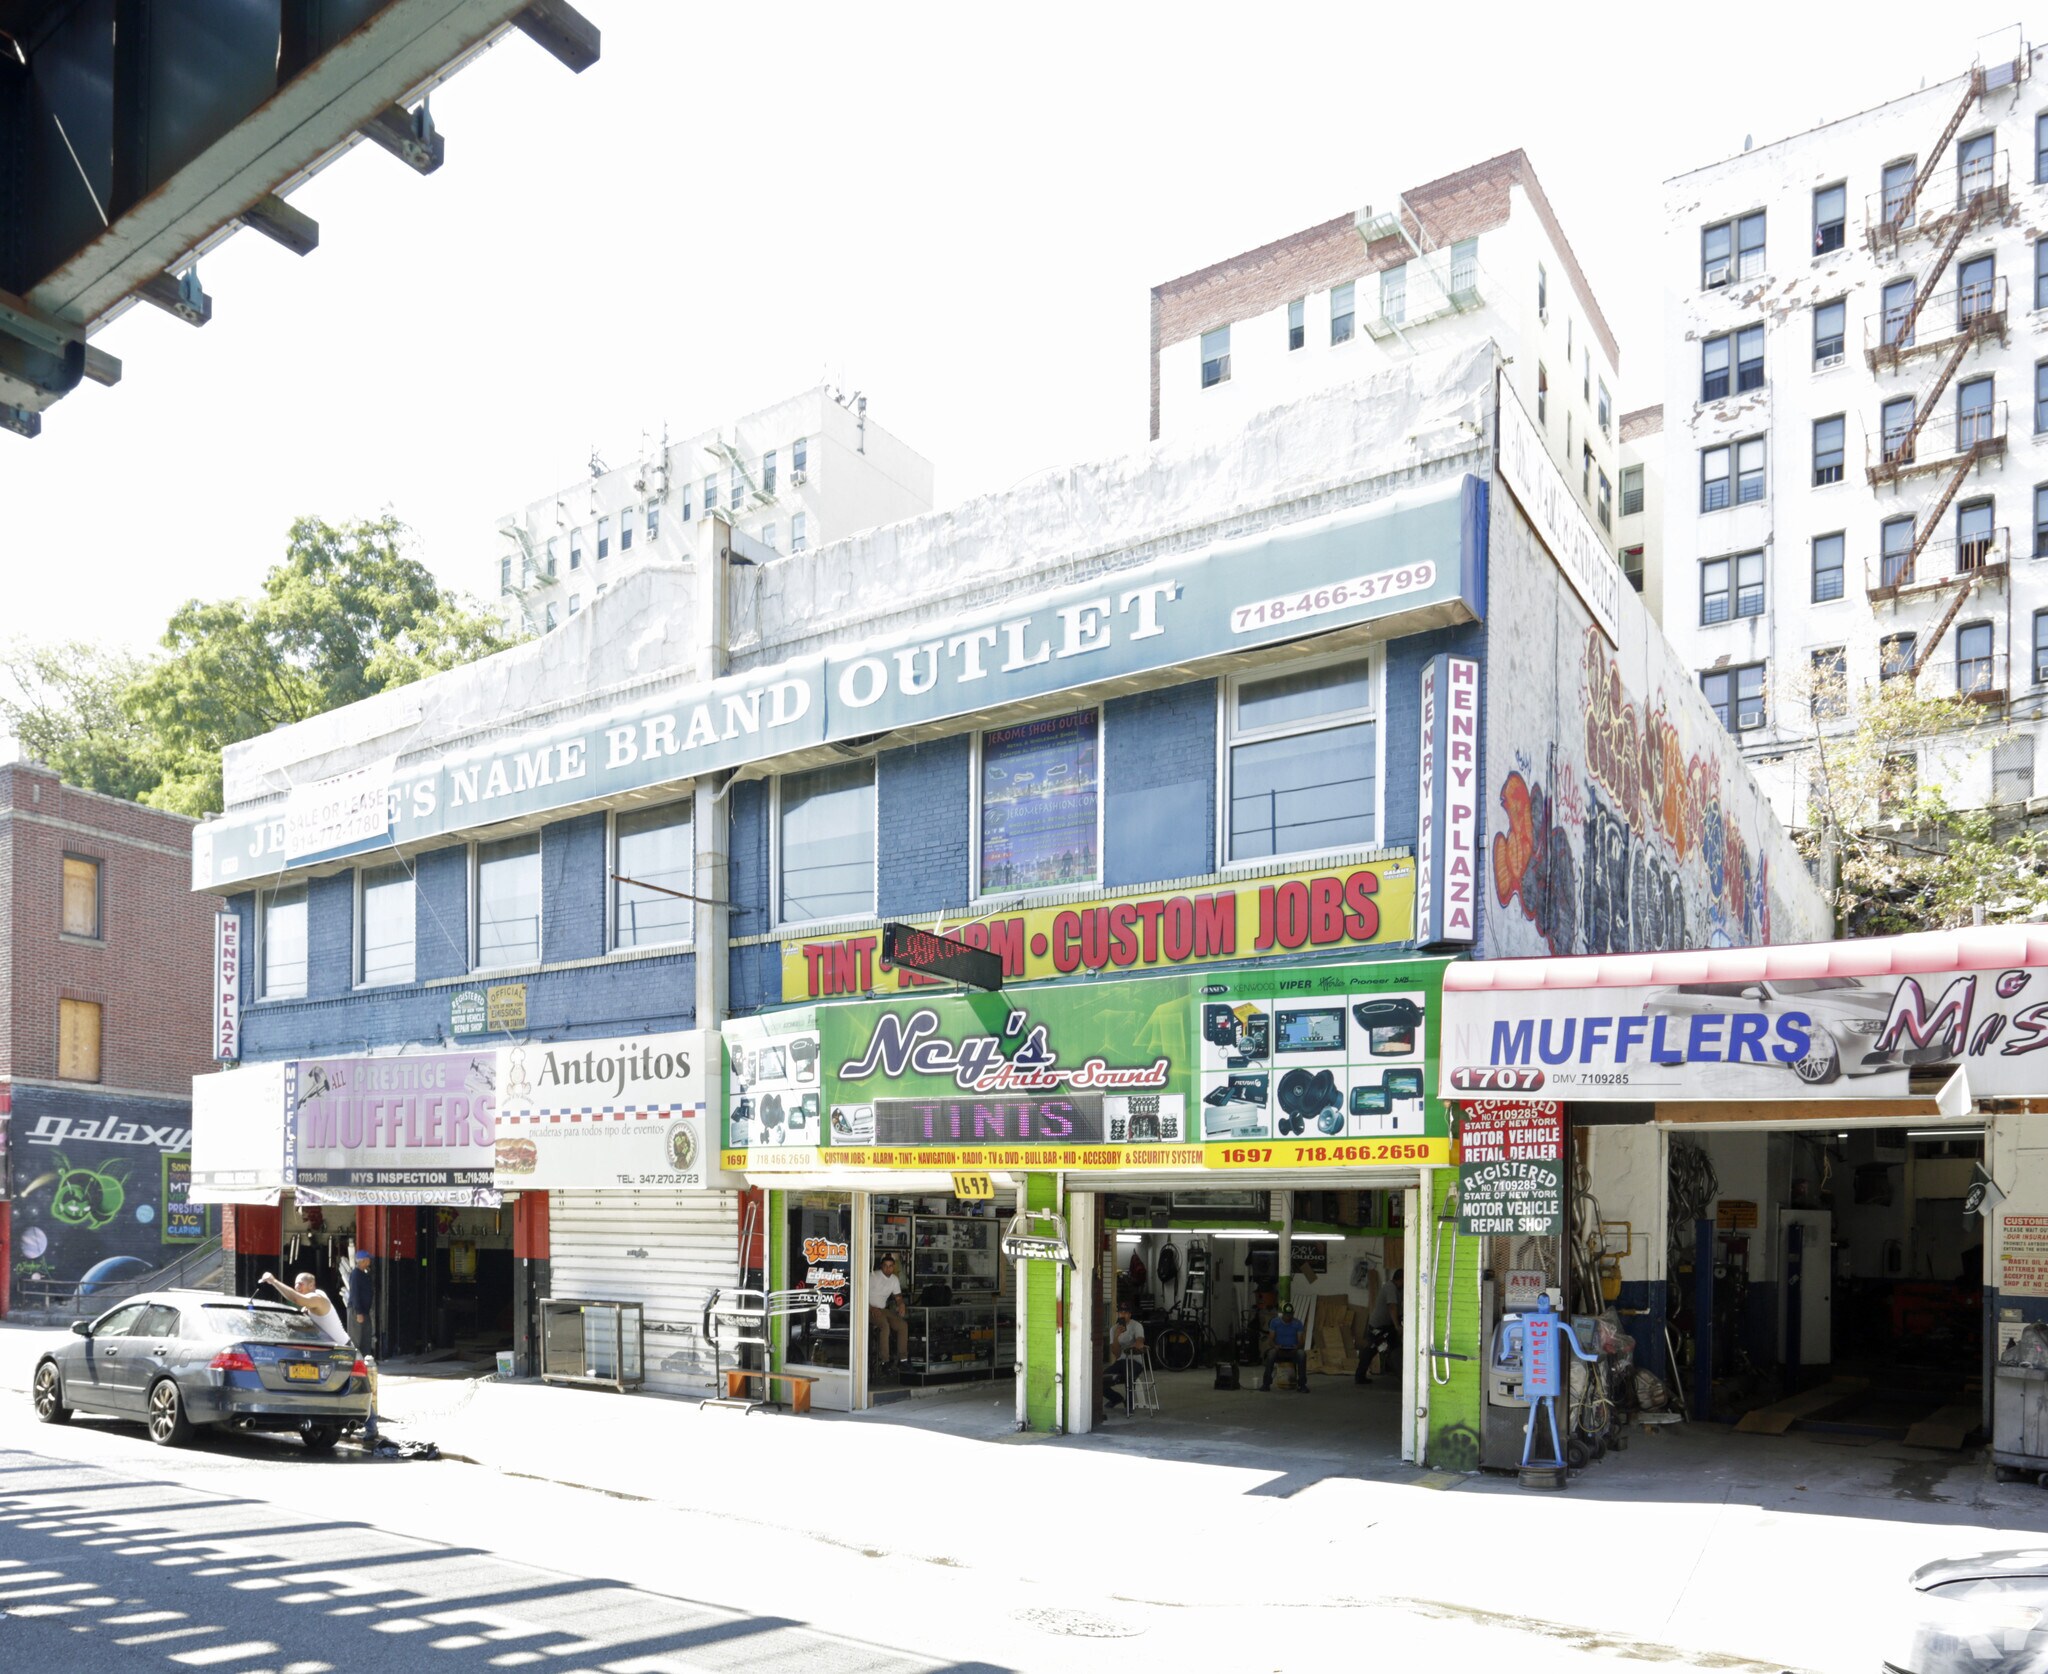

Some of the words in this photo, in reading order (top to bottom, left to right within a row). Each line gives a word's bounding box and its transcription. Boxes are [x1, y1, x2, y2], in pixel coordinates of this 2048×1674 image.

[1236, 565, 1432, 627] 718-466-3799
[249, 778, 436, 858] JEE'S
[450, 737, 588, 808] NAME
[605, 678, 811, 771] BRAND
[839, 581, 1178, 708] OUTLET
[988, 727, 1026, 746] JEROME
[1029, 719, 1056, 736] SHOES
[1059, 712, 1095, 729] OUTLET
[1452, 662, 1474, 788] HENRY
[1423, 674, 1433, 799] HENRY
[290, 807, 318, 832] SALE
[322, 801, 340, 822] OR
[344, 789, 385, 816] LEASE
[291, 813, 381, 852] 914-772-1780
[1450, 804, 1472, 928] PLAZA
[1420, 815, 1431, 939] PLAZA
[803, 936, 876, 996] TINT
[1053, 890, 1236, 972] CUSTOM
[1254, 871, 1380, 950] JOBS
[223, 920, 237, 985] HENRY
[1233, 983, 1274, 992] KENWOOD
[1279, 979, 1312, 990] VIPER
[1349, 977, 1389, 985] Pioneer
[451, 991, 485, 1009] REGISTERED
[490, 988, 523, 1002] OFFICIAL
[221, 993, 235, 1058] PLAZA
[1490, 1011, 1812, 1066] MUFFLERS
[331, 1069, 346, 1090] ALL
[353, 1062, 446, 1092] PRESTIGE
[537, 1043, 691, 1099] Antojitos
[975, 1064, 1064, 1091] Auto
[1070, 1058, 1167, 1088] Sound
[1455, 1070, 1539, 1088] 1707
[1552, 1074, 1576, 1084] DMV
[1581, 1074, 1629, 1084] 7109285
[286, 1067, 296, 1182] MUFFLERS
[306, 1095, 496, 1149] MUFFLERS
[911, 1101, 1073, 1138] TINTS
[1465, 1120, 1491, 1130] STATE
[1494, 1120, 1506, 1129] OF
[1508, 1119, 1529, 1127] NEW
[1532, 1117, 1557, 1126] YORK
[1492, 1109, 1538, 1120] 7109285
[529, 1126, 562, 1138] picaderas
[564, 1126, 579, 1138] para
[581, 1124, 602, 1136] todos
[604, 1125, 619, 1138] tipo
[622, 1123, 631, 1135] de
[633, 1124, 664, 1135] eventos
[1463, 1130, 1504, 1146] MOTOR
[1508, 1127, 1560, 1144] VEHICLE
[727, 1155, 747, 1166] 1697
[824, 1152, 849, 1165] CUSTOM
[850, 1152, 865, 1165] JOBS
[873, 1152, 894, 1165] ALARM
[898, 1152, 912, 1164] TINT
[918, 1151, 956, 1165] NAVIGATION
[962, 1151, 983, 1164] RADIO
[988, 1151, 998, 1164] TV
[1005, 1151, 1020, 1164] DVD
[1025, 1151, 1041, 1164] BULL
[1043, 1151, 1057, 1164] BAR
[1063, 1151, 1076, 1164] HID
[1083, 1151, 1121, 1164] ACCESORY
[1125, 1152, 1131, 1164] &
[1133, 1151, 1171, 1164] SECURITY
[1171, 1150, 1203, 1164] SYSTEM
[1221, 1148, 1272, 1163] 1697
[1295, 1144, 1429, 1162] 718.466.2650
[1465, 1147, 1506, 1162] RETAIL
[1510, 1144, 1557, 1161] DEALER
[299, 1173, 328, 1183] 1703-1705
[352, 1173, 373, 1183] NYS
[377, 1172, 446, 1183] INSPECTION
[617, 1174, 636, 1184] TEL:
[639, 1174, 699, 1184] 347.270.2723
[954, 1175, 989, 1196] 1697
[1464, 1162, 1557, 1191] REGISTERED
[1493, 1180, 1537, 1191] 7109285
[170, 1182, 190, 1193] MT
[355, 1188, 472, 1204] CONDITIONED
[1464, 1191, 1491, 1200] STATE
[1494, 1191, 1506, 1200] OF
[1508, 1190, 1529, 1199] NEW
[1532, 1189, 1557, 1198] YORK
[1463, 1202, 1503, 1216] MOTOR
[1507, 1200, 1559, 1216] VEHICLE
[171, 1214, 198, 1225] JVC
[1471, 1218, 1513, 1232] REPAIR
[1518, 1217, 1552, 1232] SHOP
[168, 1226, 201, 1234] CLARION
[804, 1239, 847, 1261] Signs
[1510, 1275, 1541, 1287] ATM
[1530, 1321, 1548, 1384] MUFFLER
